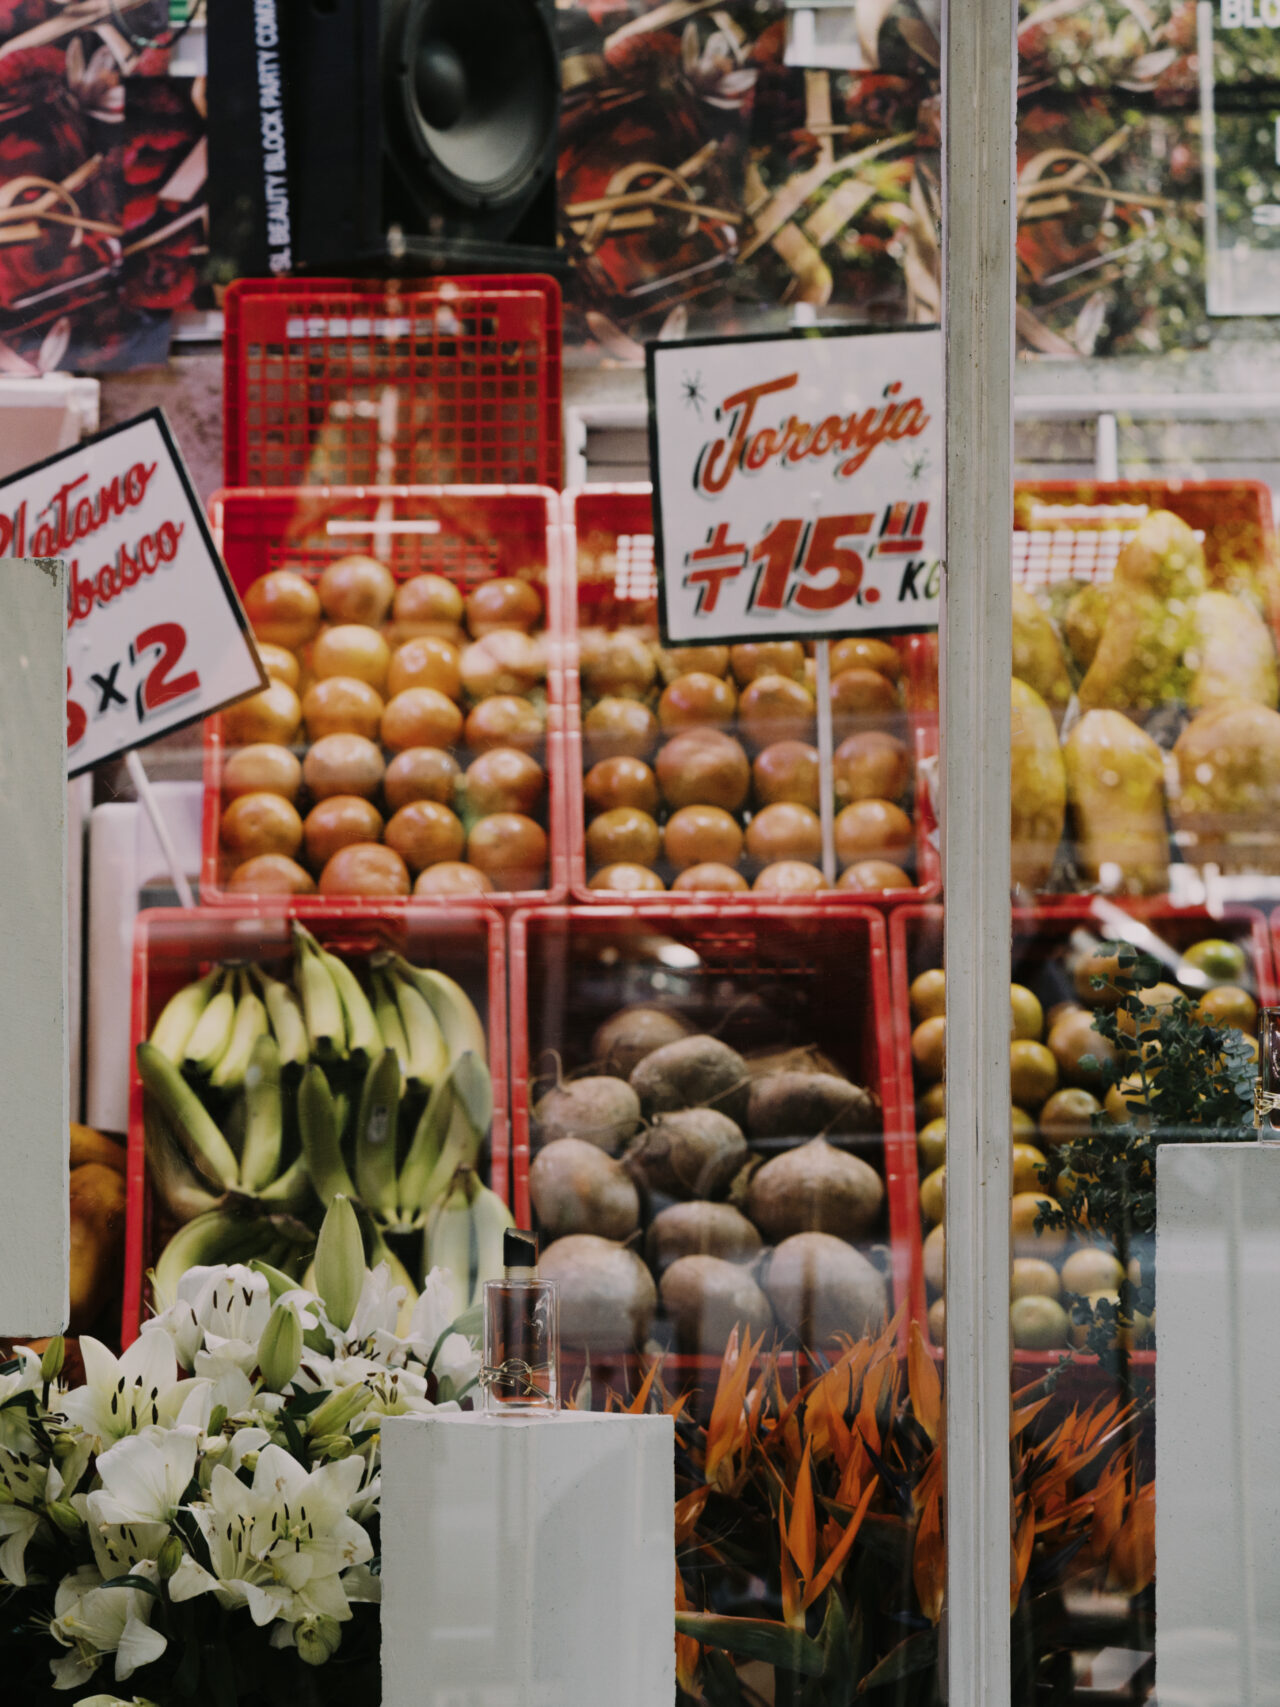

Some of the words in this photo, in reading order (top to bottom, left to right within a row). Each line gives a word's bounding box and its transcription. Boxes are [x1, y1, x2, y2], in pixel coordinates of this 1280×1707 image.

[260, 109, 286, 172] BLOCK
[693, 371, 931, 494] Toronja
[67, 519, 185, 631] basco
